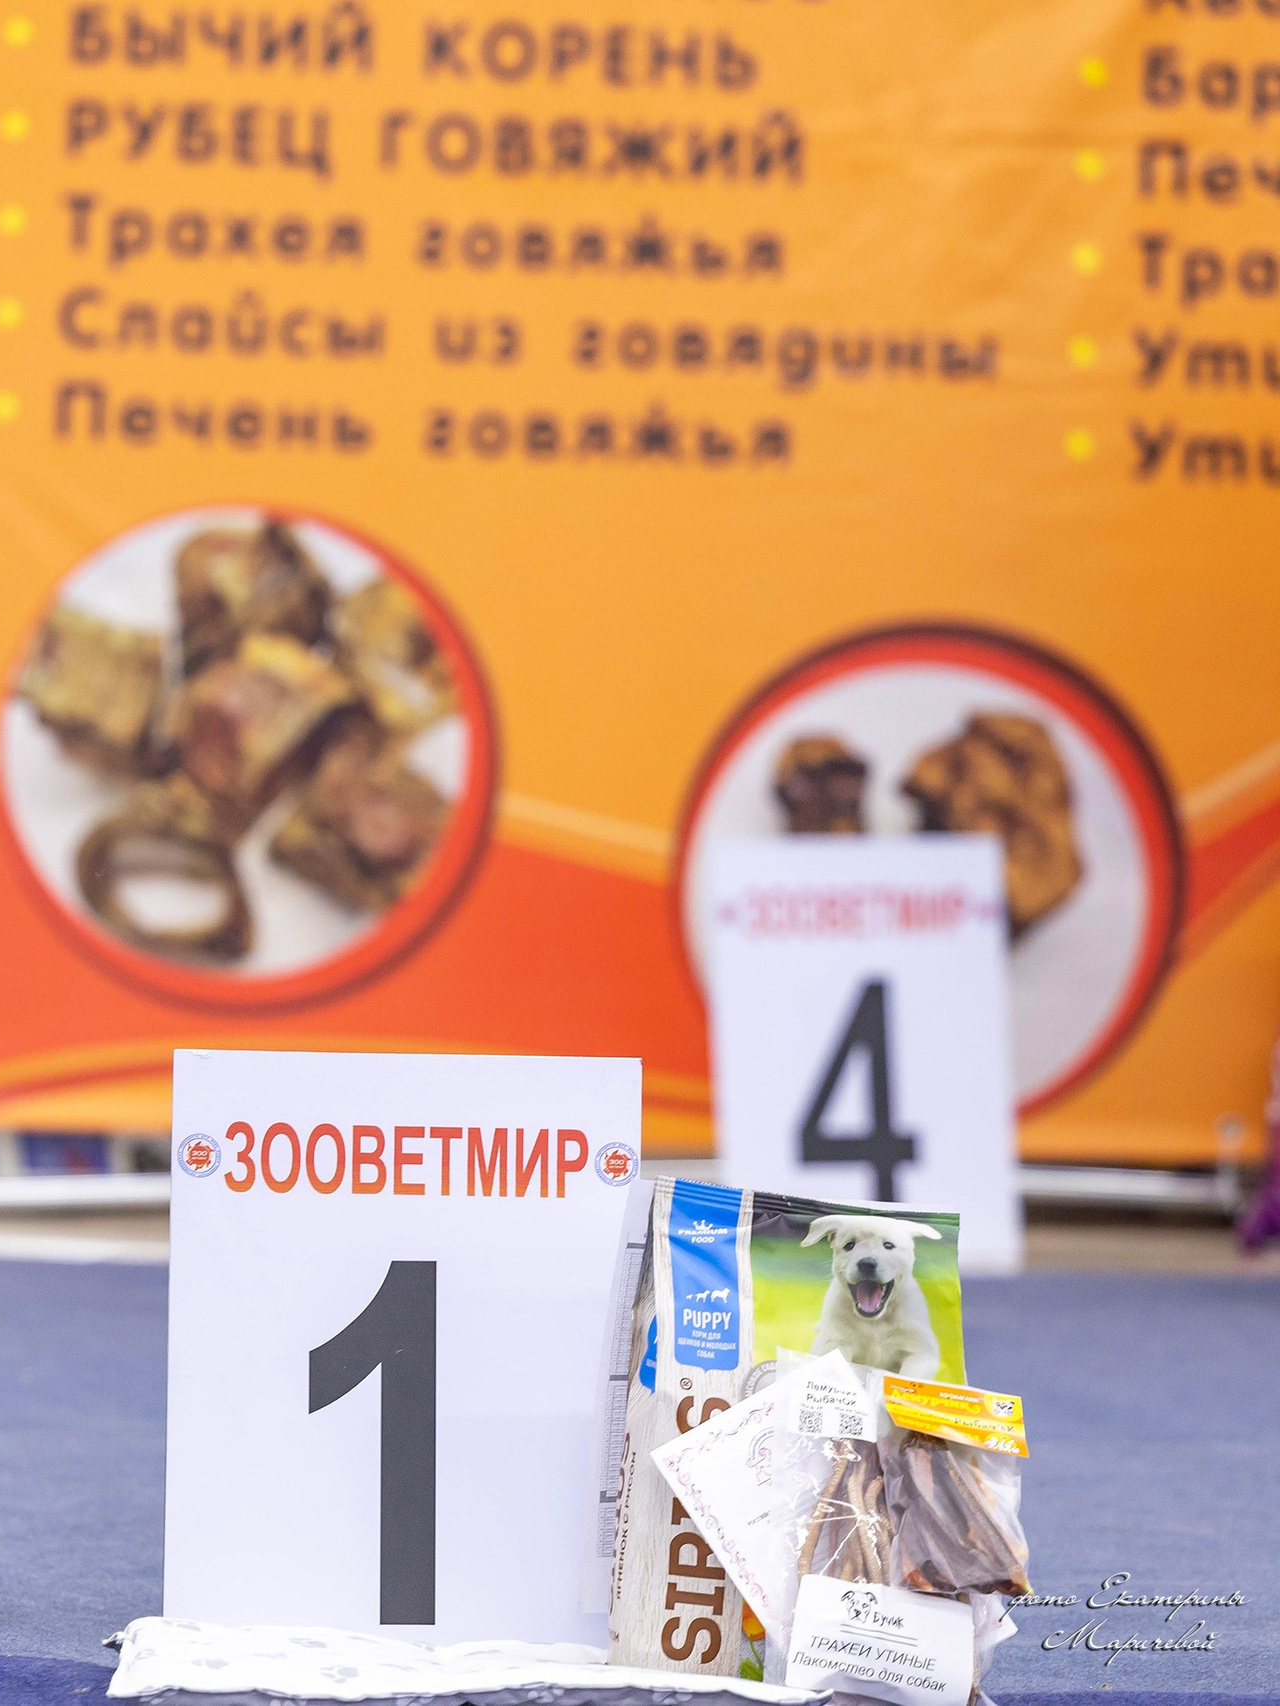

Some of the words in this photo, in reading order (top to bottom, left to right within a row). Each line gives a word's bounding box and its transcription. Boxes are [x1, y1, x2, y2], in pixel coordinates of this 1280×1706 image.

[68, 2, 374, 70] БЫЧИЙ
[423, 20, 758, 91] КОРЕНЬ
[64, 98, 332, 180] РУБЕЦ
[380, 109, 806, 184] ГОВЯЖИЙ
[64, 192, 367, 268] Трахея
[1134, 230, 1280, 310] Тра
[56, 286, 386, 358] Слайсы
[572, 320, 999, 392] говядины
[54, 379, 372, 454] Печень
[798, 979, 917, 1202] 4
[223, 1120, 590, 1199] ЗООВЕТМИР
[691, 1236, 715, 1244] FOOD
[682, 1308, 733, 1330] PUPPY
[308, 1259, 438, 1626] 1
[660, 1395, 732, 1665] SIRS
[792, 1651, 875, 1678] Лакомство
[878, 1667, 904, 1687] для
[906, 1675, 948, 1693] собак
[810, 1635, 872, 1659] ТРАХЕИ
[875, 1647, 938, 1672] УТИНЫЕ
